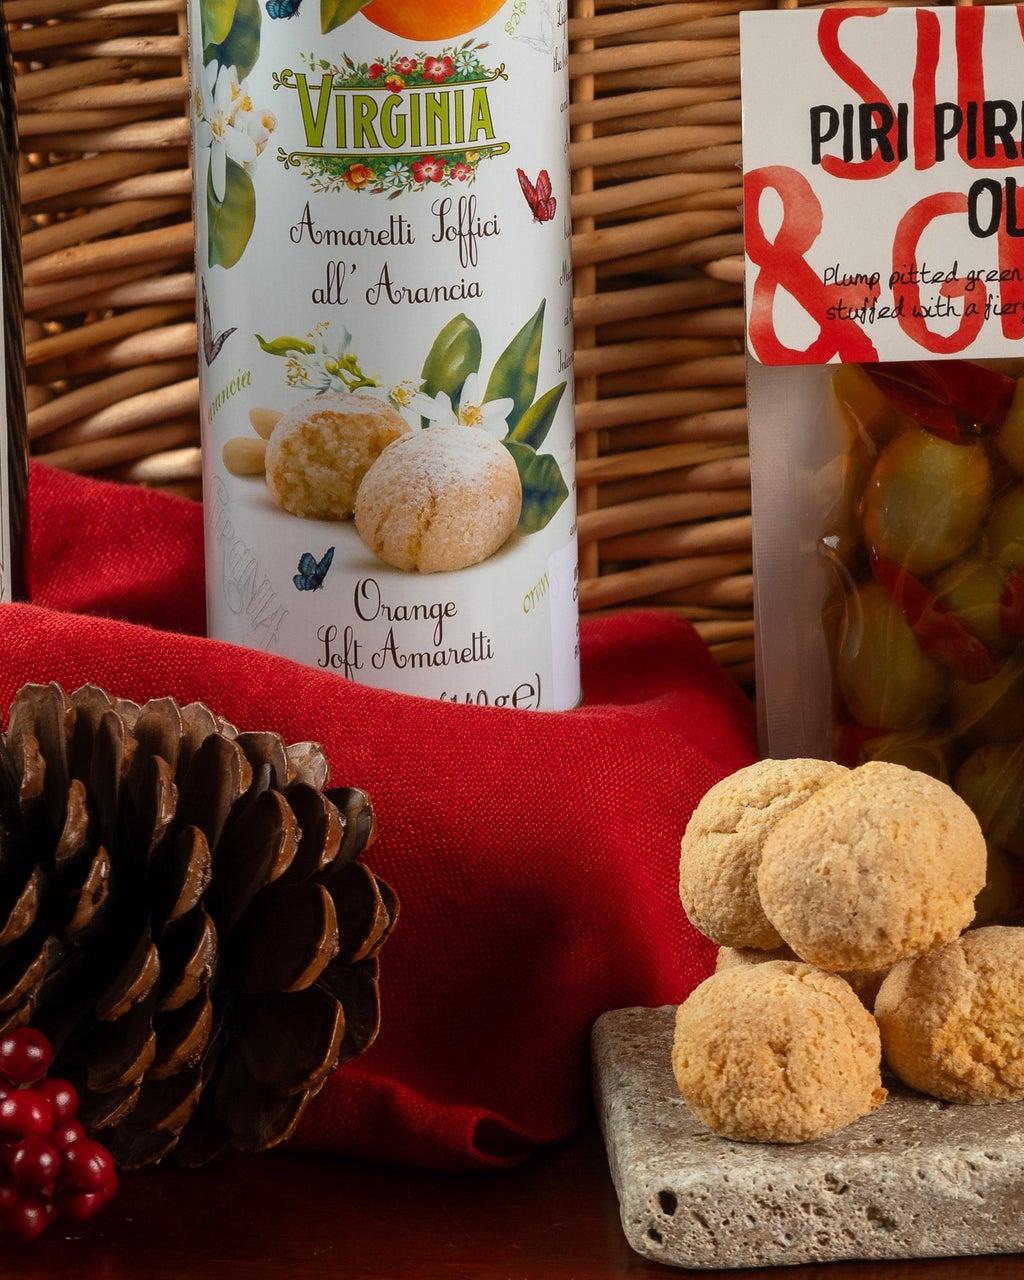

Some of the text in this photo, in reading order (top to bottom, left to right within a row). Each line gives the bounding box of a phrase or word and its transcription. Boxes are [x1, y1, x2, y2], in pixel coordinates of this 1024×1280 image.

[293, 73, 497, 149] VIRGINIA
[809, 101, 908, 165] PIRI
[289, 200, 416, 246] Amaretti
[431, 195, 501, 269] Soffici
[365, 261, 483, 305] Arancia
[742, 165, 881, 366] &
[823, 264, 881, 290] Plump
[888, 260, 959, 290] pitted
[964, 269, 1023, 291] green
[826, 296, 906, 325] stuffed
[912, 295, 961, 318] with
[964, 300, 982, 317] a
[353, 577, 458, 646] Orange
[317, 624, 494, 679] Soft Amaretti
